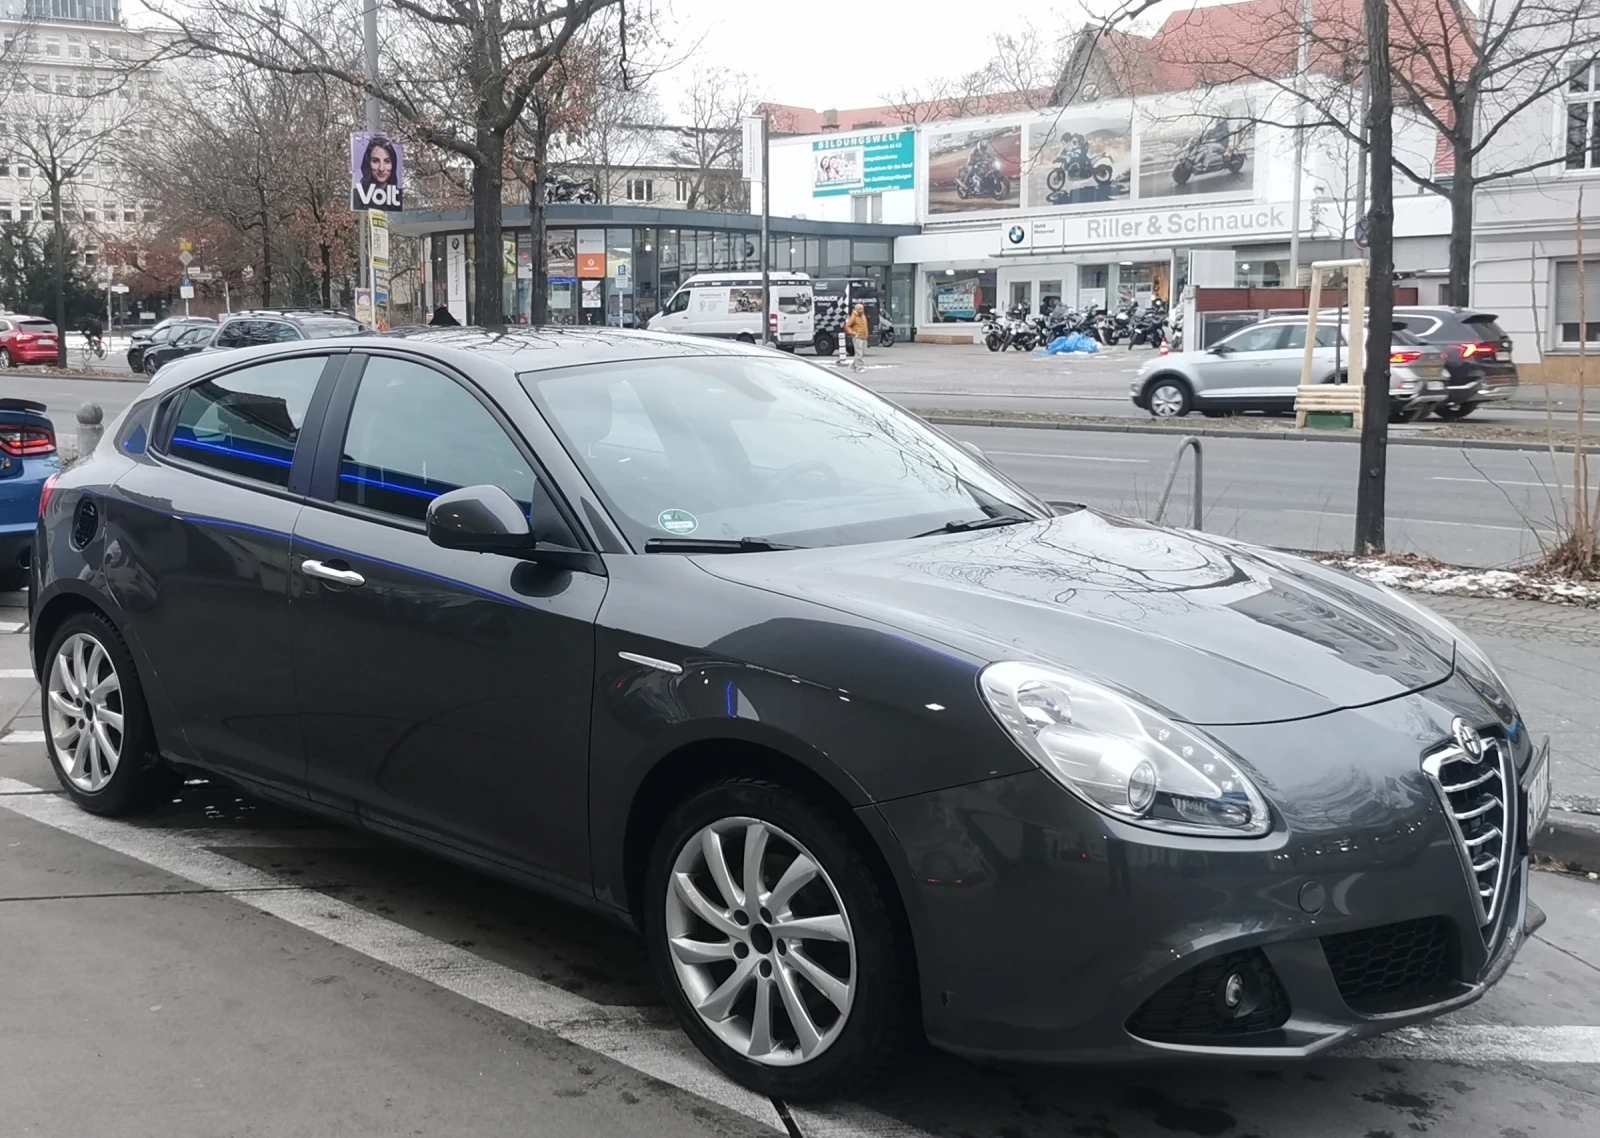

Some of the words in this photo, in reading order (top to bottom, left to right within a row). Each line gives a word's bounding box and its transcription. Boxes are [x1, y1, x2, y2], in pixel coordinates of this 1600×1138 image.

[818, 132, 901, 149] BILDUNGSWELT
[356, 183, 401, 207] Volt
[1087, 218, 1143, 240] Riller
[1146, 215, 1162, 235] &
[1166, 206, 1284, 234] Schnauck
